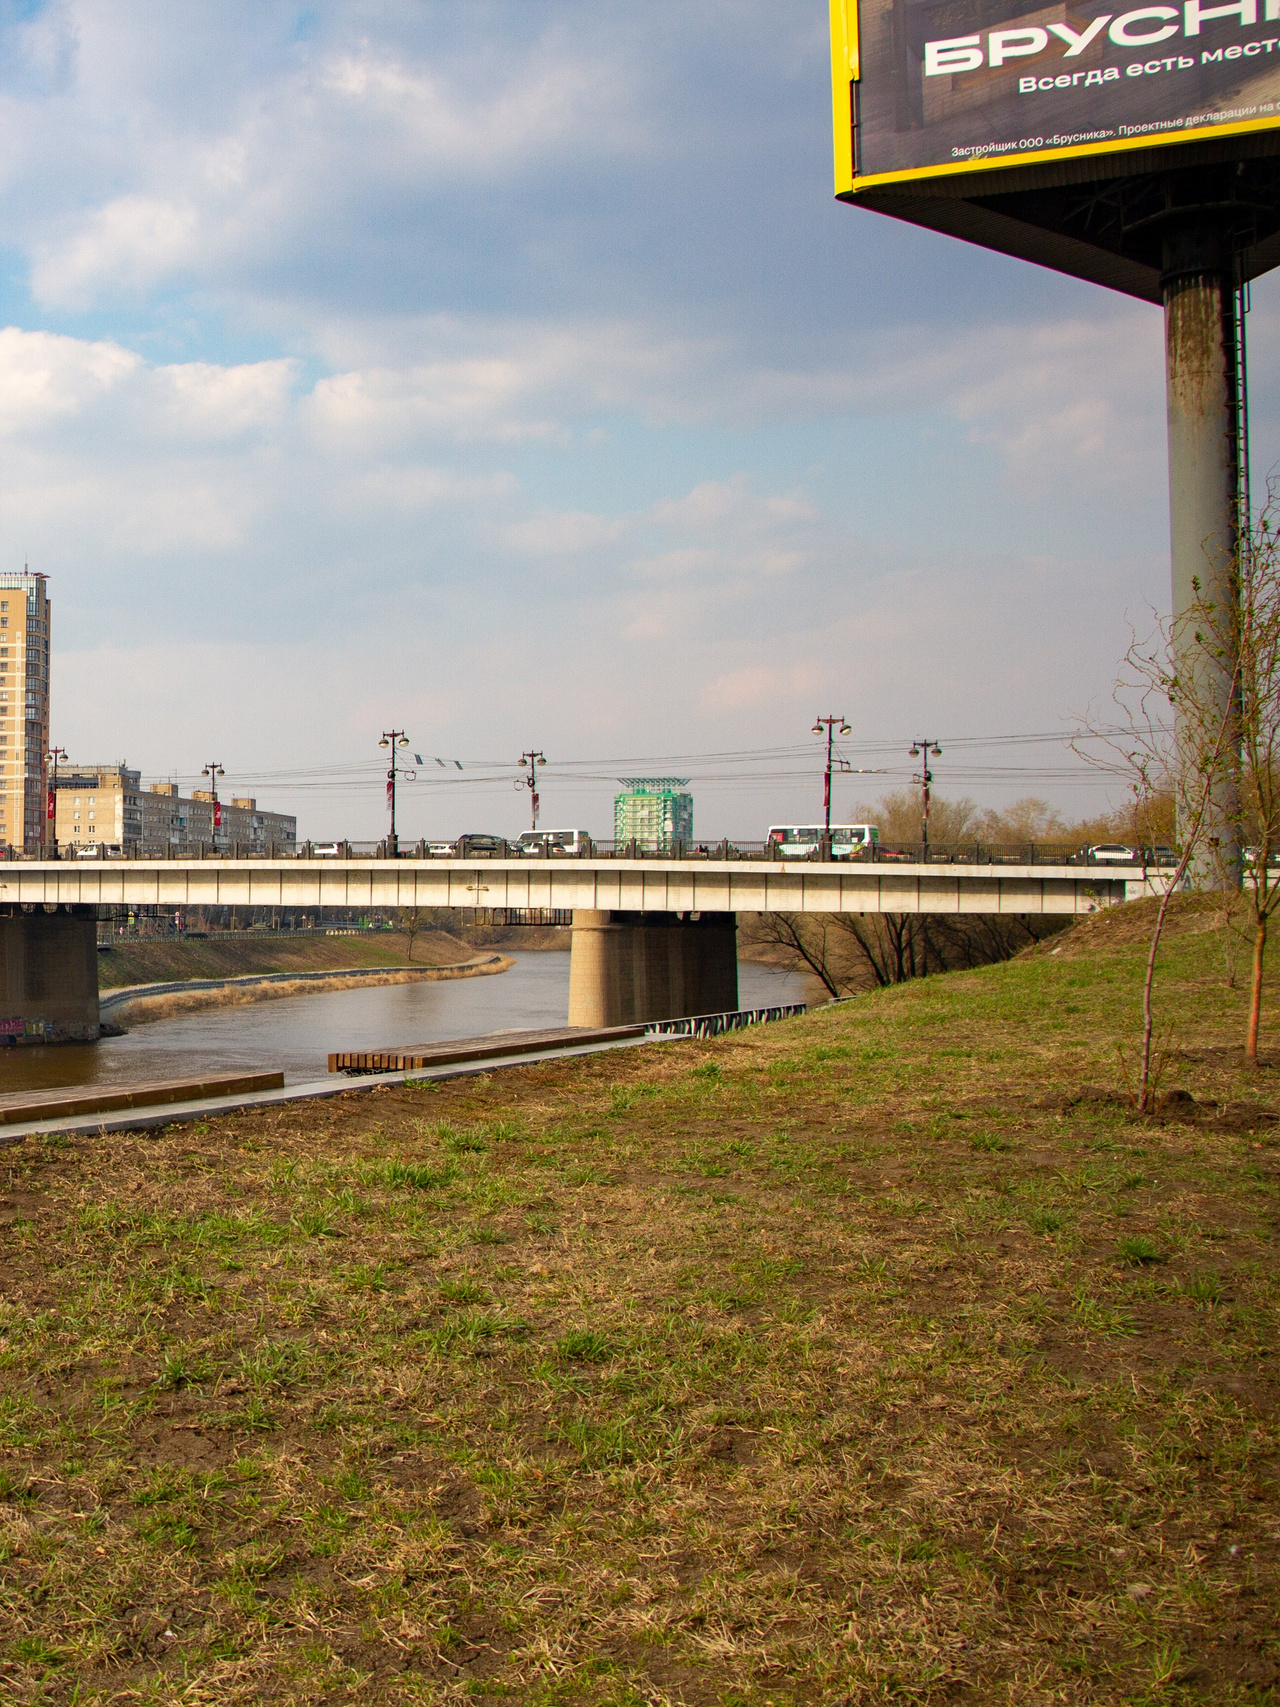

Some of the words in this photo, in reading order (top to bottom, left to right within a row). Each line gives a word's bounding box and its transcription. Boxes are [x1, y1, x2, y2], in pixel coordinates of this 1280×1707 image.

[925, 0, 1280, 77] БРУСН
[1019, 66, 1120, 93] Всегда
[1126, 54, 1195, 78] есть
[1201, 37, 1280, 65] мест
[951, 140, 1018, 158] Застройщик
[1019, 136, 1044, 150] ООО
[1045, 129, 1116, 147] «Брусника».
[1118, 119, 1183, 137] Проектные
[1185, 105, 1257, 128] декларации
[1259, 102, 1275, 113] на
